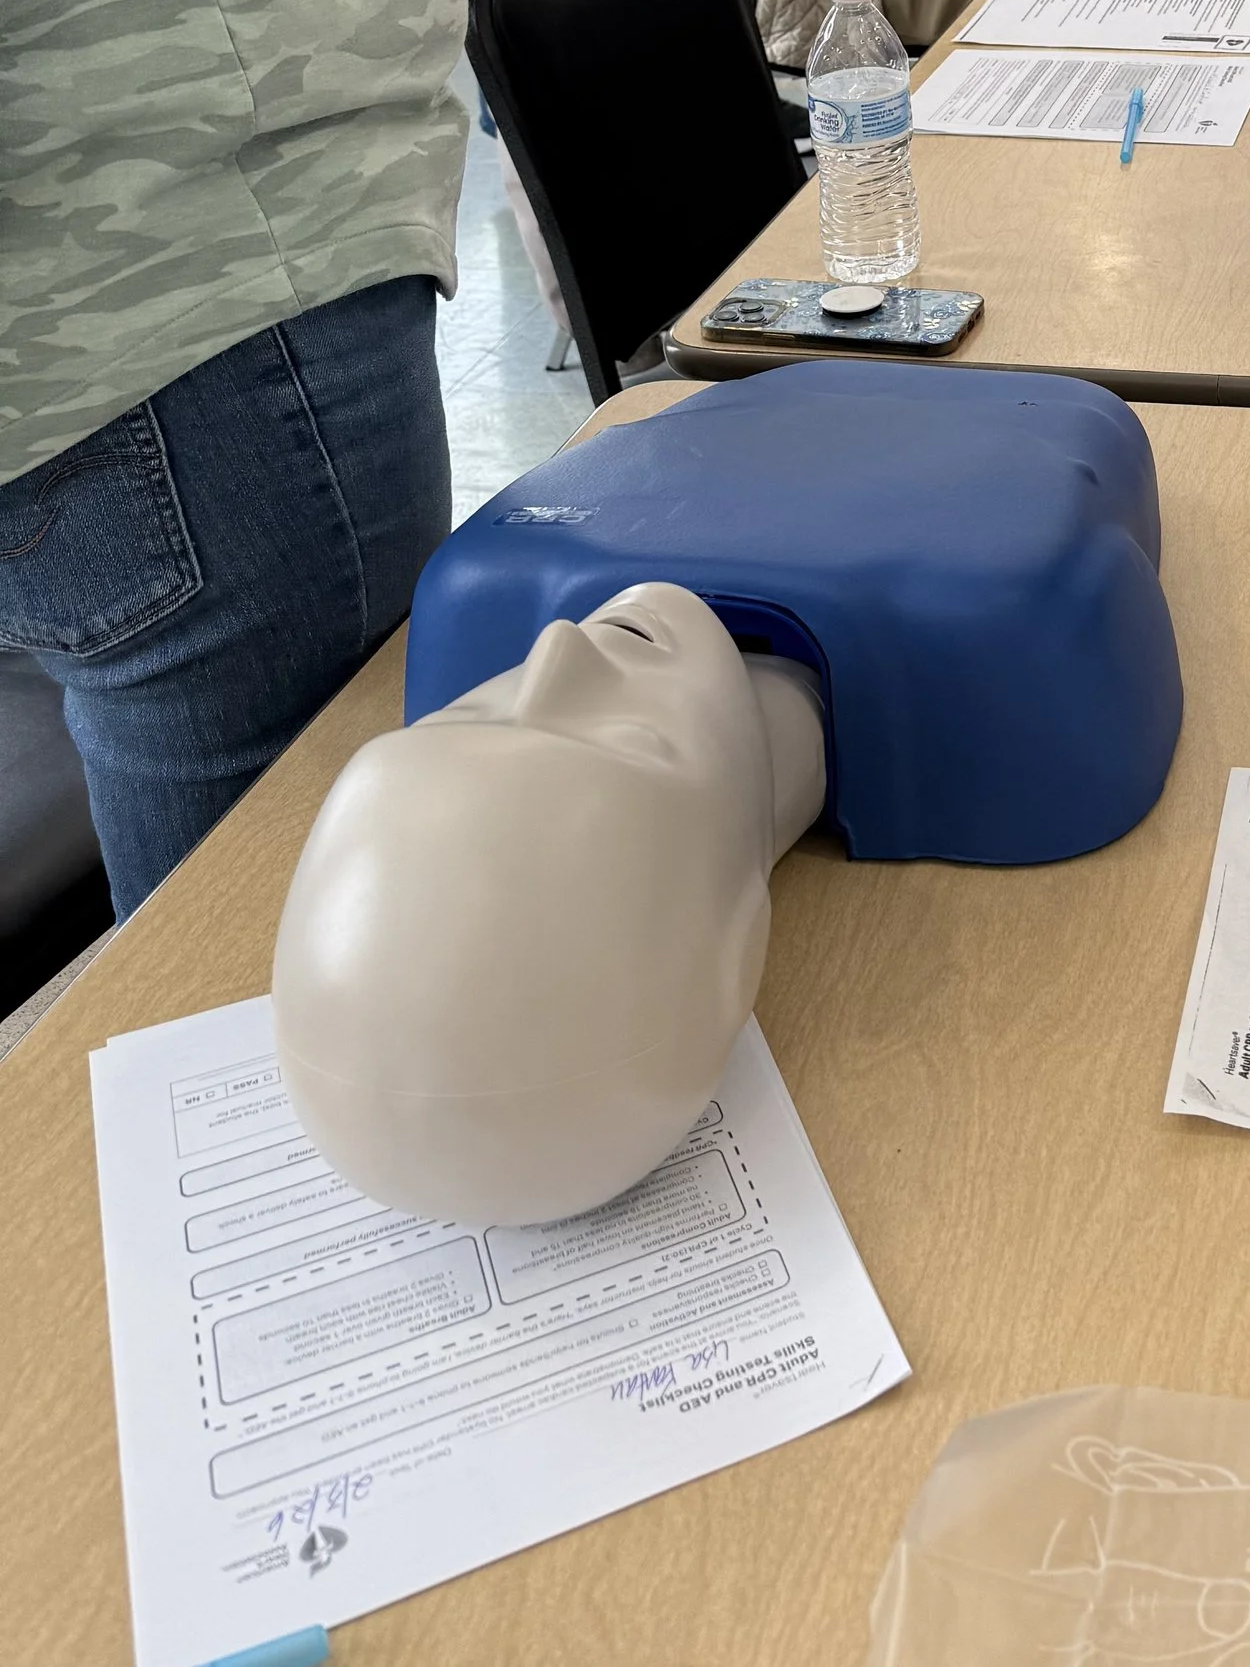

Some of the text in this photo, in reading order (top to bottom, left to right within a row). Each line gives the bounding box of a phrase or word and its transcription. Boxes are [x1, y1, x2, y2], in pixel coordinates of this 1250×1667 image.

[637, 1335, 816, 1413] Skills Testing Checklist
[677, 1347, 821, 1415] Adult CPR and AED
